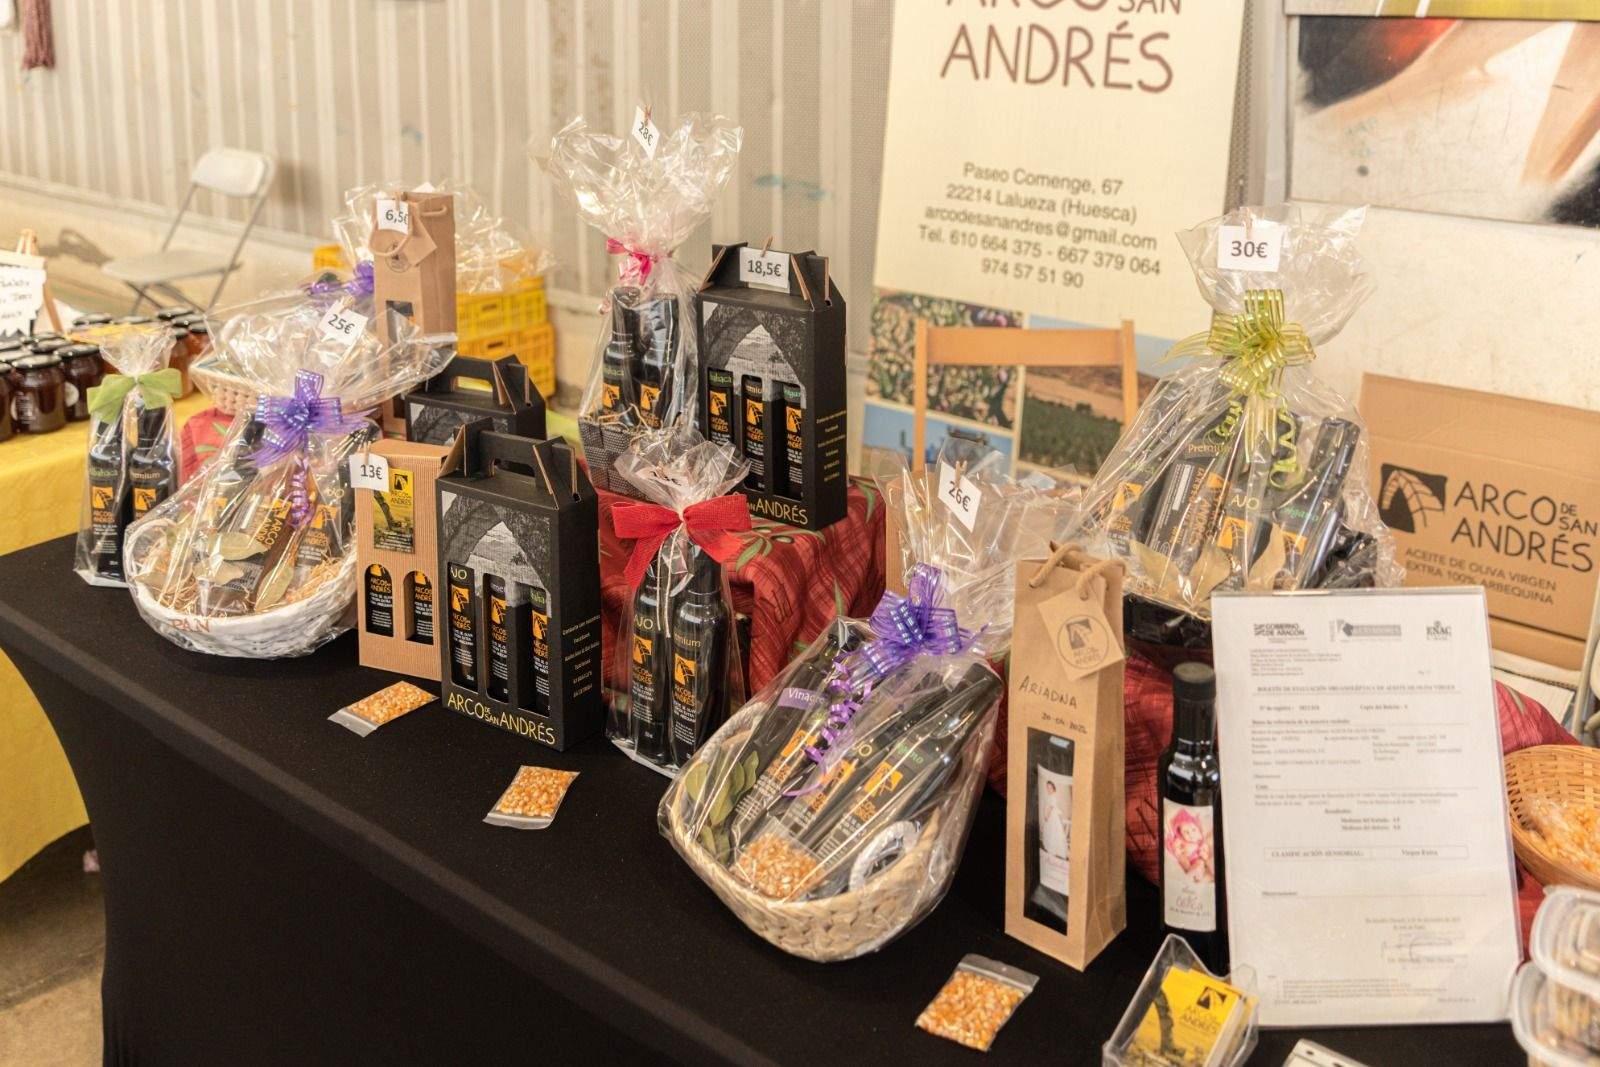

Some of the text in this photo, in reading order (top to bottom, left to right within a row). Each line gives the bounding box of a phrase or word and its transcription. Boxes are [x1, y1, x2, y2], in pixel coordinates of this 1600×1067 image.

[940, 20, 1174, 94] ANDRÉS
[963, 162, 1123, 197] Paseo Comenge, 67
[946, 184, 1138, 225] 22214 Lalueza (Huesca)
[924, 204, 1158, 250] arcodesanandres@gmail.com
[747, 259, 782, 277] 18,5€
[918, 225, 945, 244] Tel.
[950, 229, 979, 248] 610
[981, 234, 1008, 252] 664
[1012, 239, 1043, 258] 375
[1058, 244, 1090, 264] 667
[1093, 251, 1125, 271] 379
[1129, 257, 1161, 276] 064
[1231, 241, 1268, 258] 30€
[981, 258, 1084, 288] 974 57 51 90
[328, 314, 355, 335] 25€
[360, 464, 383, 481] 13€
[756, 498, 808, 525] ANDRÉS
[948, 480, 971, 512] 26€
[1454, 481, 1598, 537] ARCO DE SAN
[1451, 517, 1594, 573] ANDRÉS
[1406, 547, 1557, 592] ACEITE DE OLIVA VIRGEN
[1406, 559, 1554, 605] EXTRA 100% ARBEQUINA
[448, 692, 484, 720] ARCO
[484, 713, 499, 726] SAN
[499, 709, 556, 745] ANDRÉS
